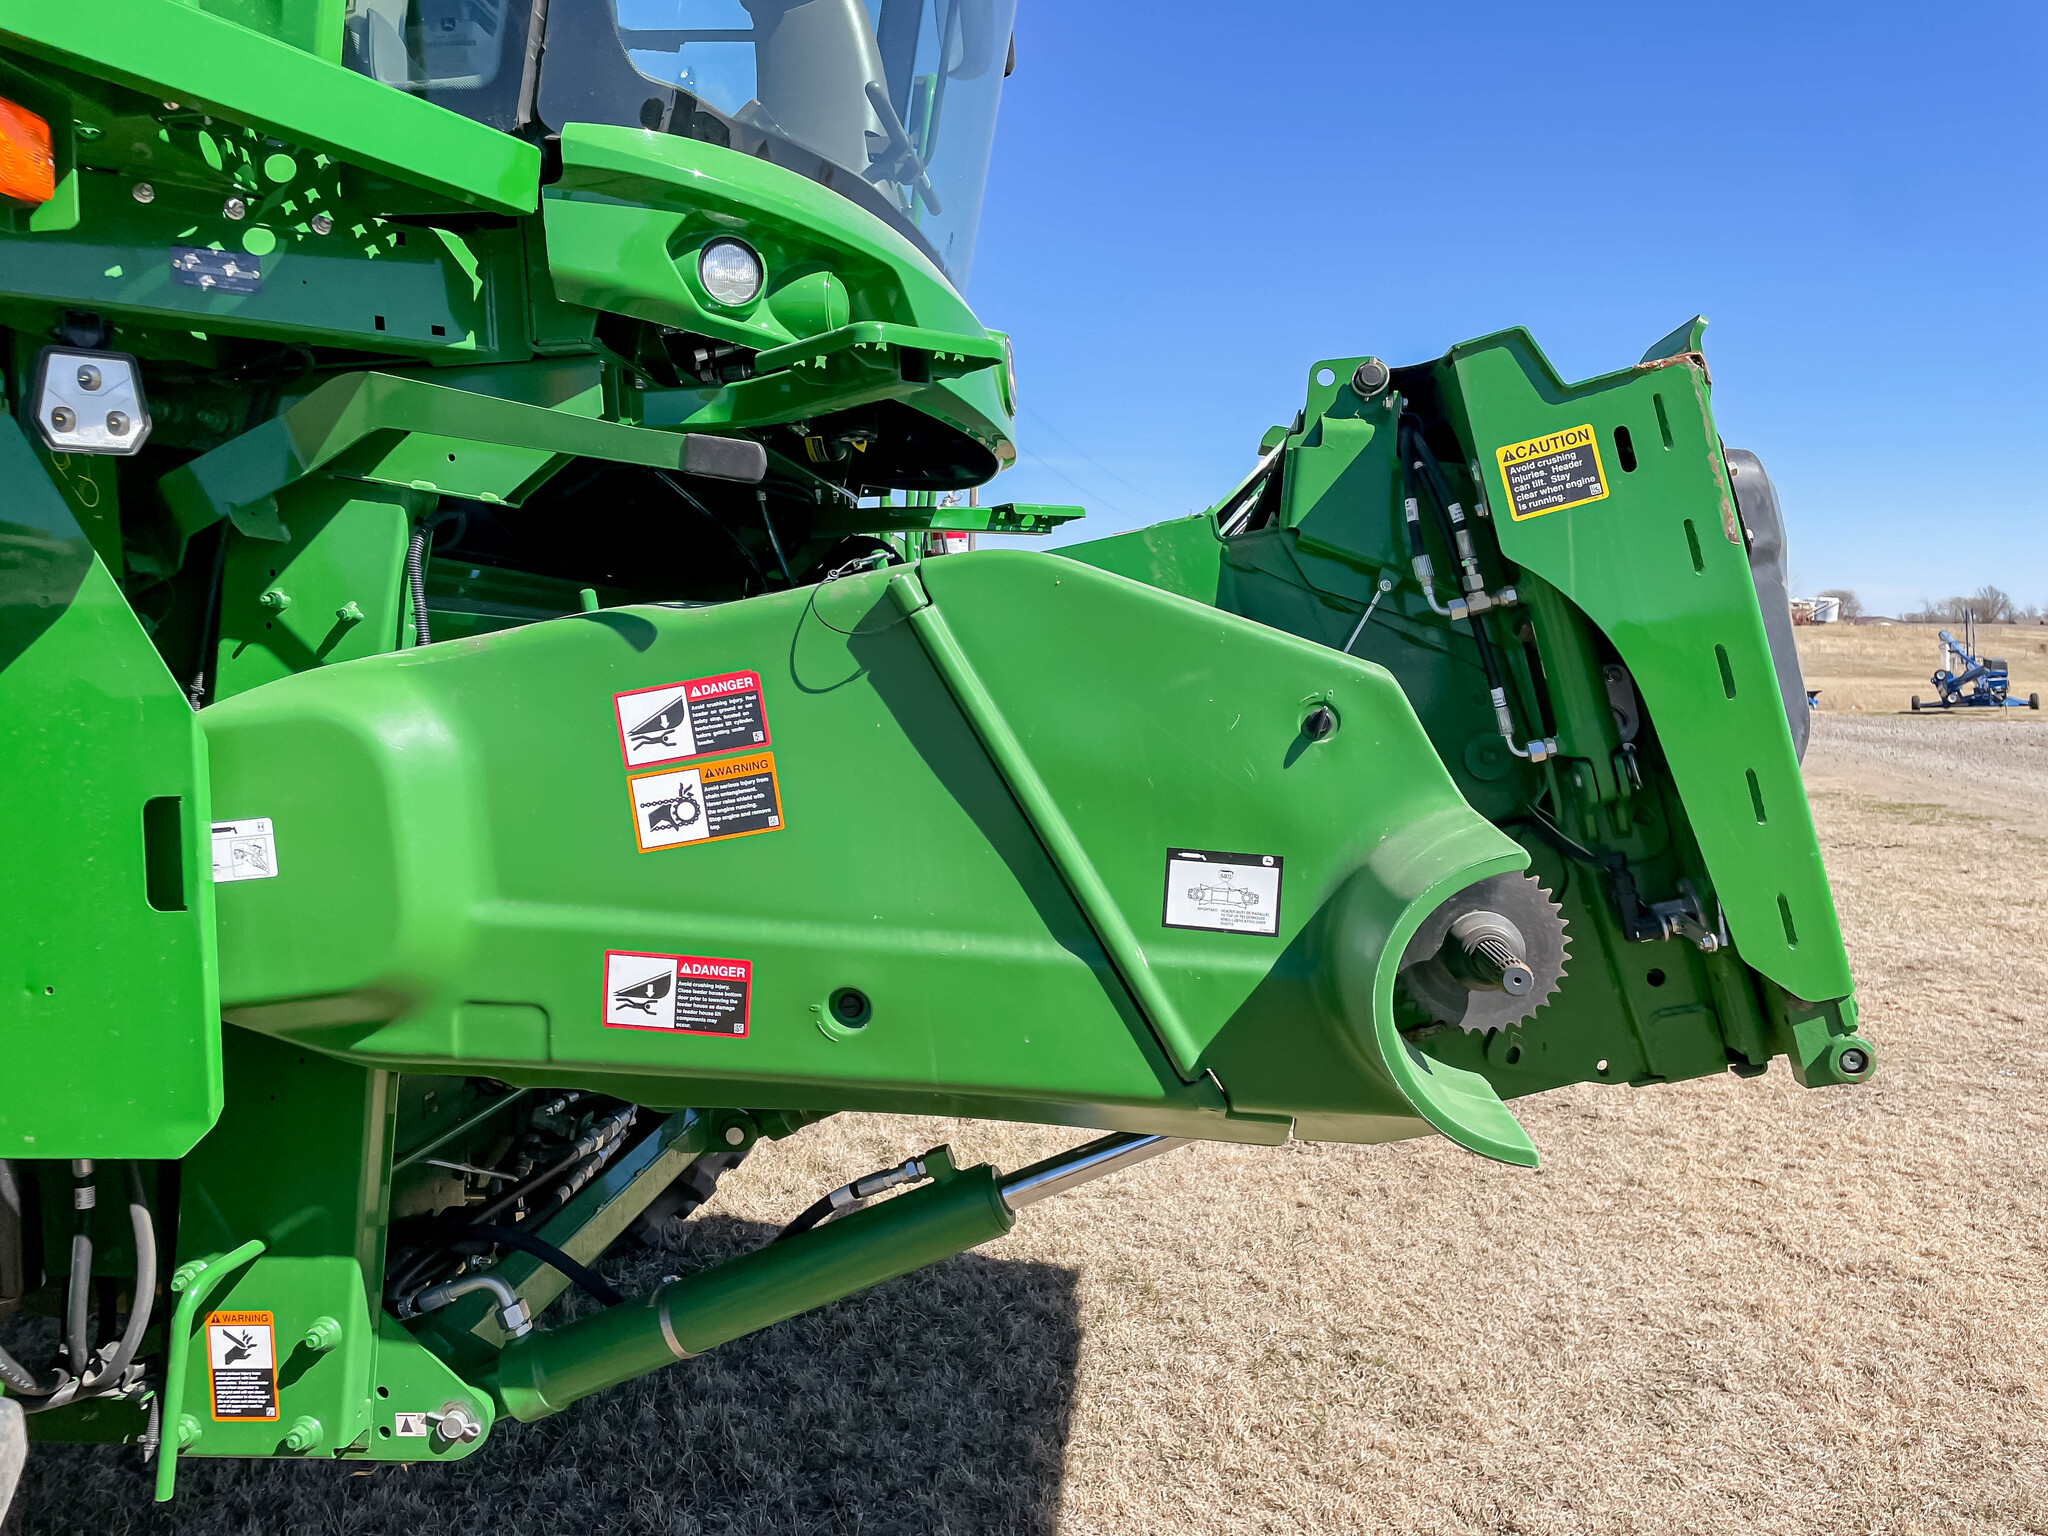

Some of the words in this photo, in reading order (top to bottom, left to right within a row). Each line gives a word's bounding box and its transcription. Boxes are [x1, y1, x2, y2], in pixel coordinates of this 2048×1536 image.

[1516, 429, 1589, 458] CAUTION
[1510, 462, 1535, 475] Avoid
[1537, 452, 1576, 467] crushing
[1512, 469, 1547, 484] injuries.
[1551, 460, 1582, 473] Header
[1514, 484, 1530, 492] can
[1532, 479, 1547, 488] tilt.
[1551, 473, 1570, 483] Stay
[1517, 491, 1538, 501] clear
[1540, 484, 1564, 495] when
[1566, 476, 1595, 489] engine
[1529, 494, 1566, 508] running.
[701, 677, 753, 695] DANGER
[719, 706, 736, 714] ground
[715, 760, 768, 776] WARNING
[720, 787, 757, 796] entanglement.
[693, 964, 745, 978] DANGER
[223, 1314, 268, 1322] WARNING
